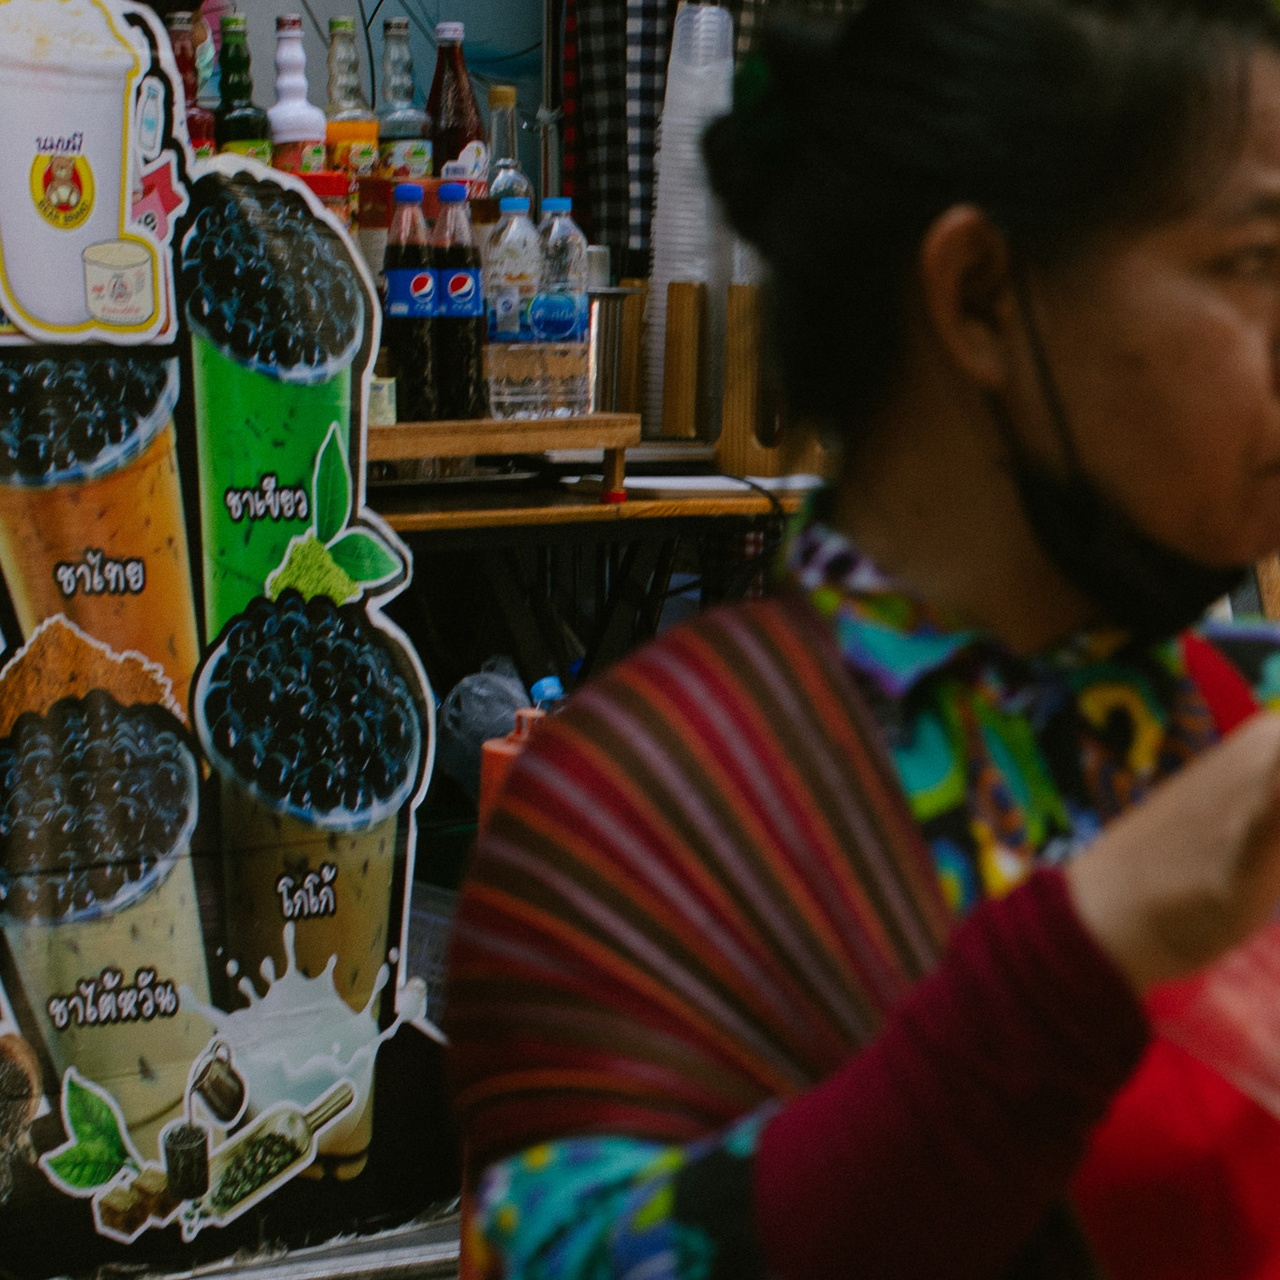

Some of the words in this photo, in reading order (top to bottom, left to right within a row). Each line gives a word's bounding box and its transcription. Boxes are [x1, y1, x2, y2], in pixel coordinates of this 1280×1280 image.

[225, 475, 309, 520] ชาเขียว
[57, 551, 145, 595] ชาไทย
[277, 864, 337, 918] โกโก้
[49, 970, 177, 1028] ชาไต้หวัน
